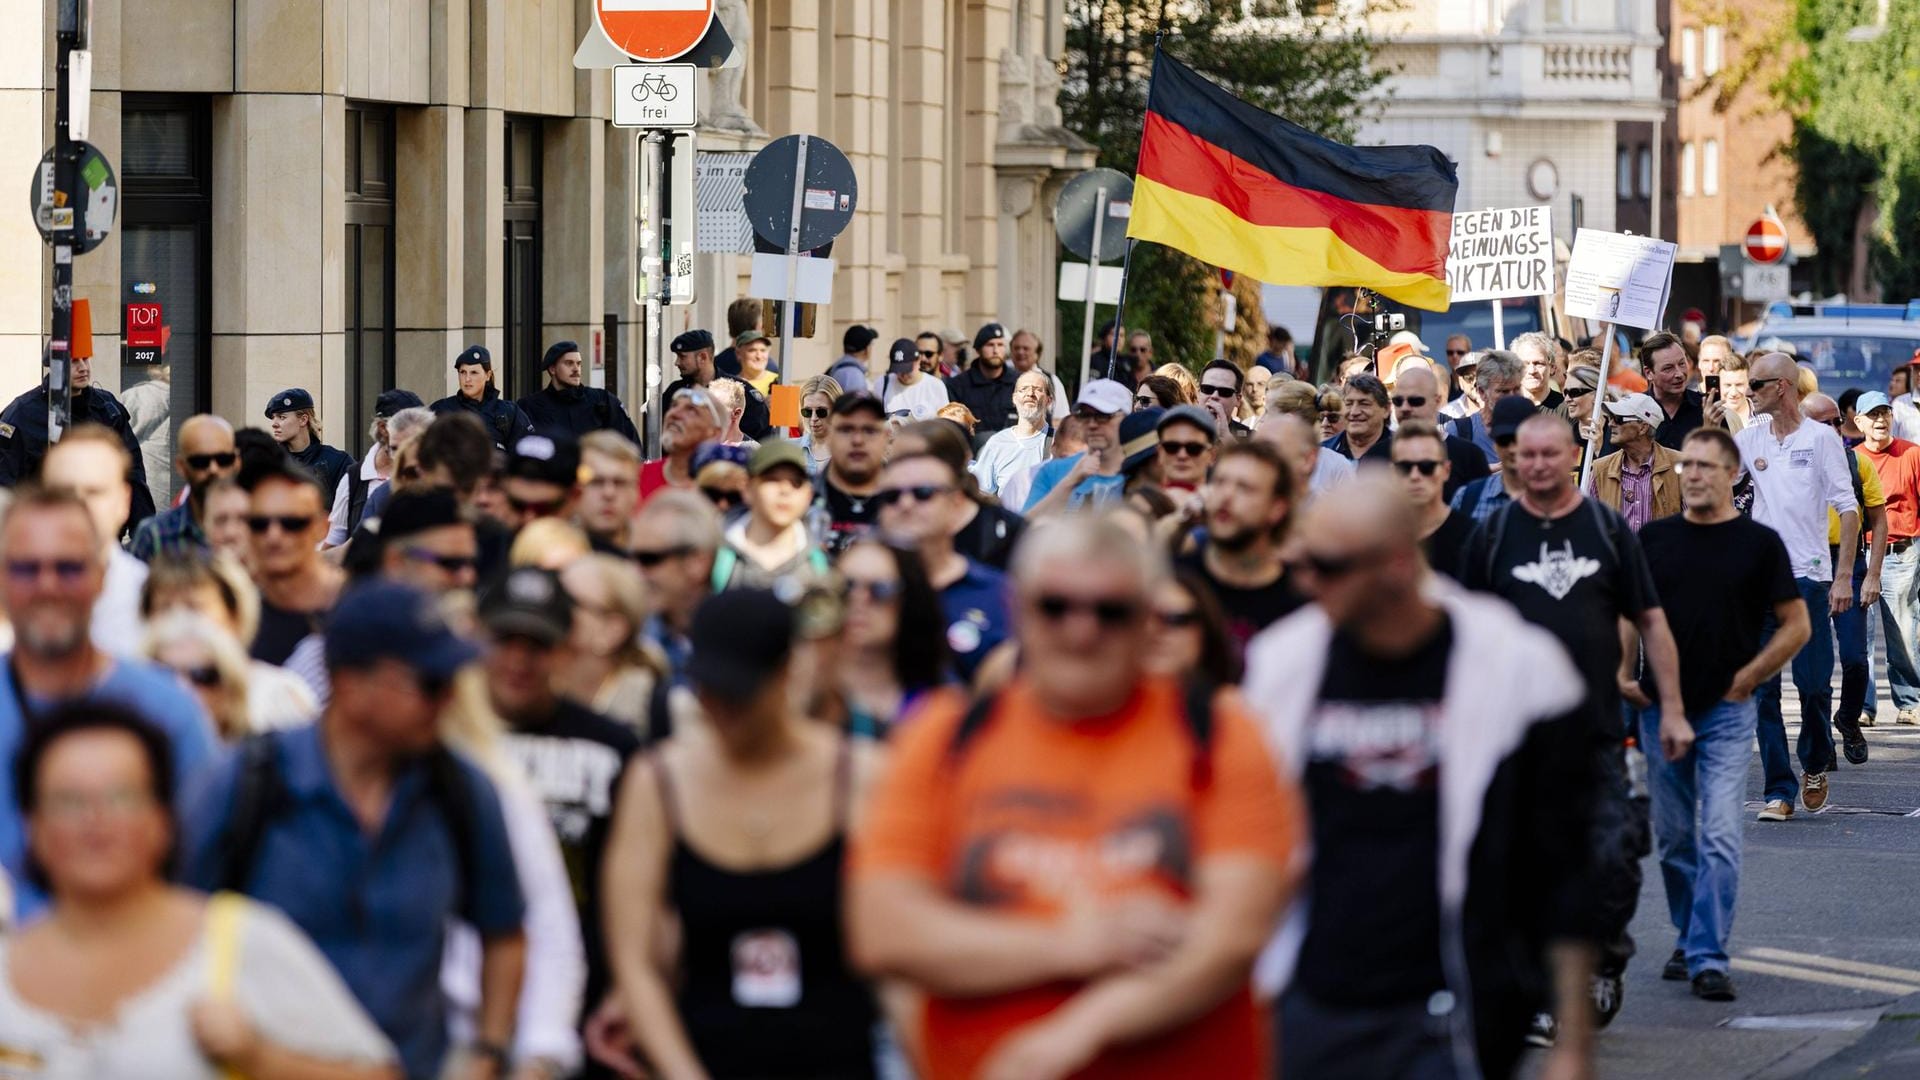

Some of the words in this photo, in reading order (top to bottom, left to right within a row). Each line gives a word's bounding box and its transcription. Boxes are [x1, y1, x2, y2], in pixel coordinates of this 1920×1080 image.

[641, 106, 668, 119] frei
[706, 164, 724, 177] im
[1453, 214, 1503, 237] EGEN
[1510, 207, 1539, 229] DIE
[129, 307, 159, 325] TOP
[135, 351, 155, 362] 2017
